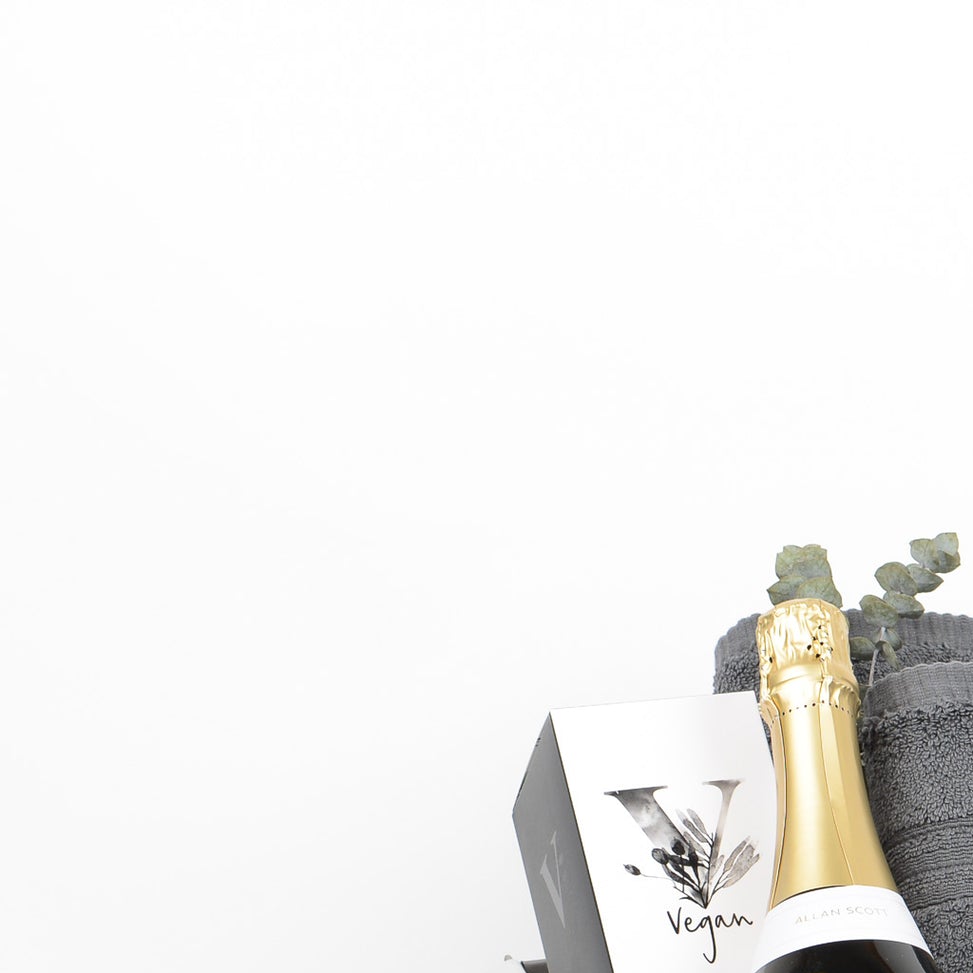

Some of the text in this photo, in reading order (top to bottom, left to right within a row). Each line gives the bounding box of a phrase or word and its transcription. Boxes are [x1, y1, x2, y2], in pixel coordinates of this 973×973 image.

[795, 906, 888, 924] ALLAN SCOTT
[666, 907, 754, 964] Vegan
